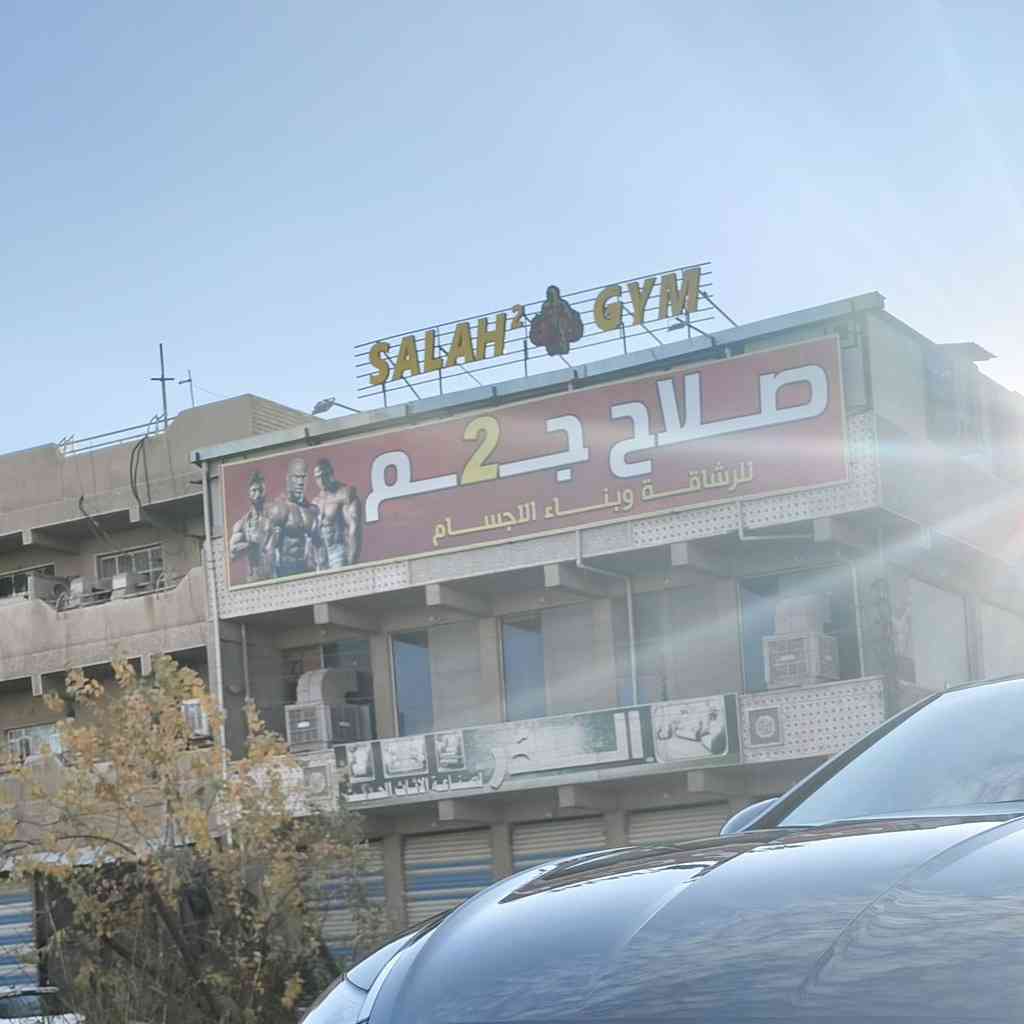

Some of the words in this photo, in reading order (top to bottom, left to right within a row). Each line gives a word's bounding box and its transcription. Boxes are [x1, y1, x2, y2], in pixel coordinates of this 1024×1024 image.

[593, 268, 702, 332] GYM
[609, 364, 830, 478] صلاح
[544, 487, 634, 519] وبناء
[642, 461, 753, 501] للرشاقة
